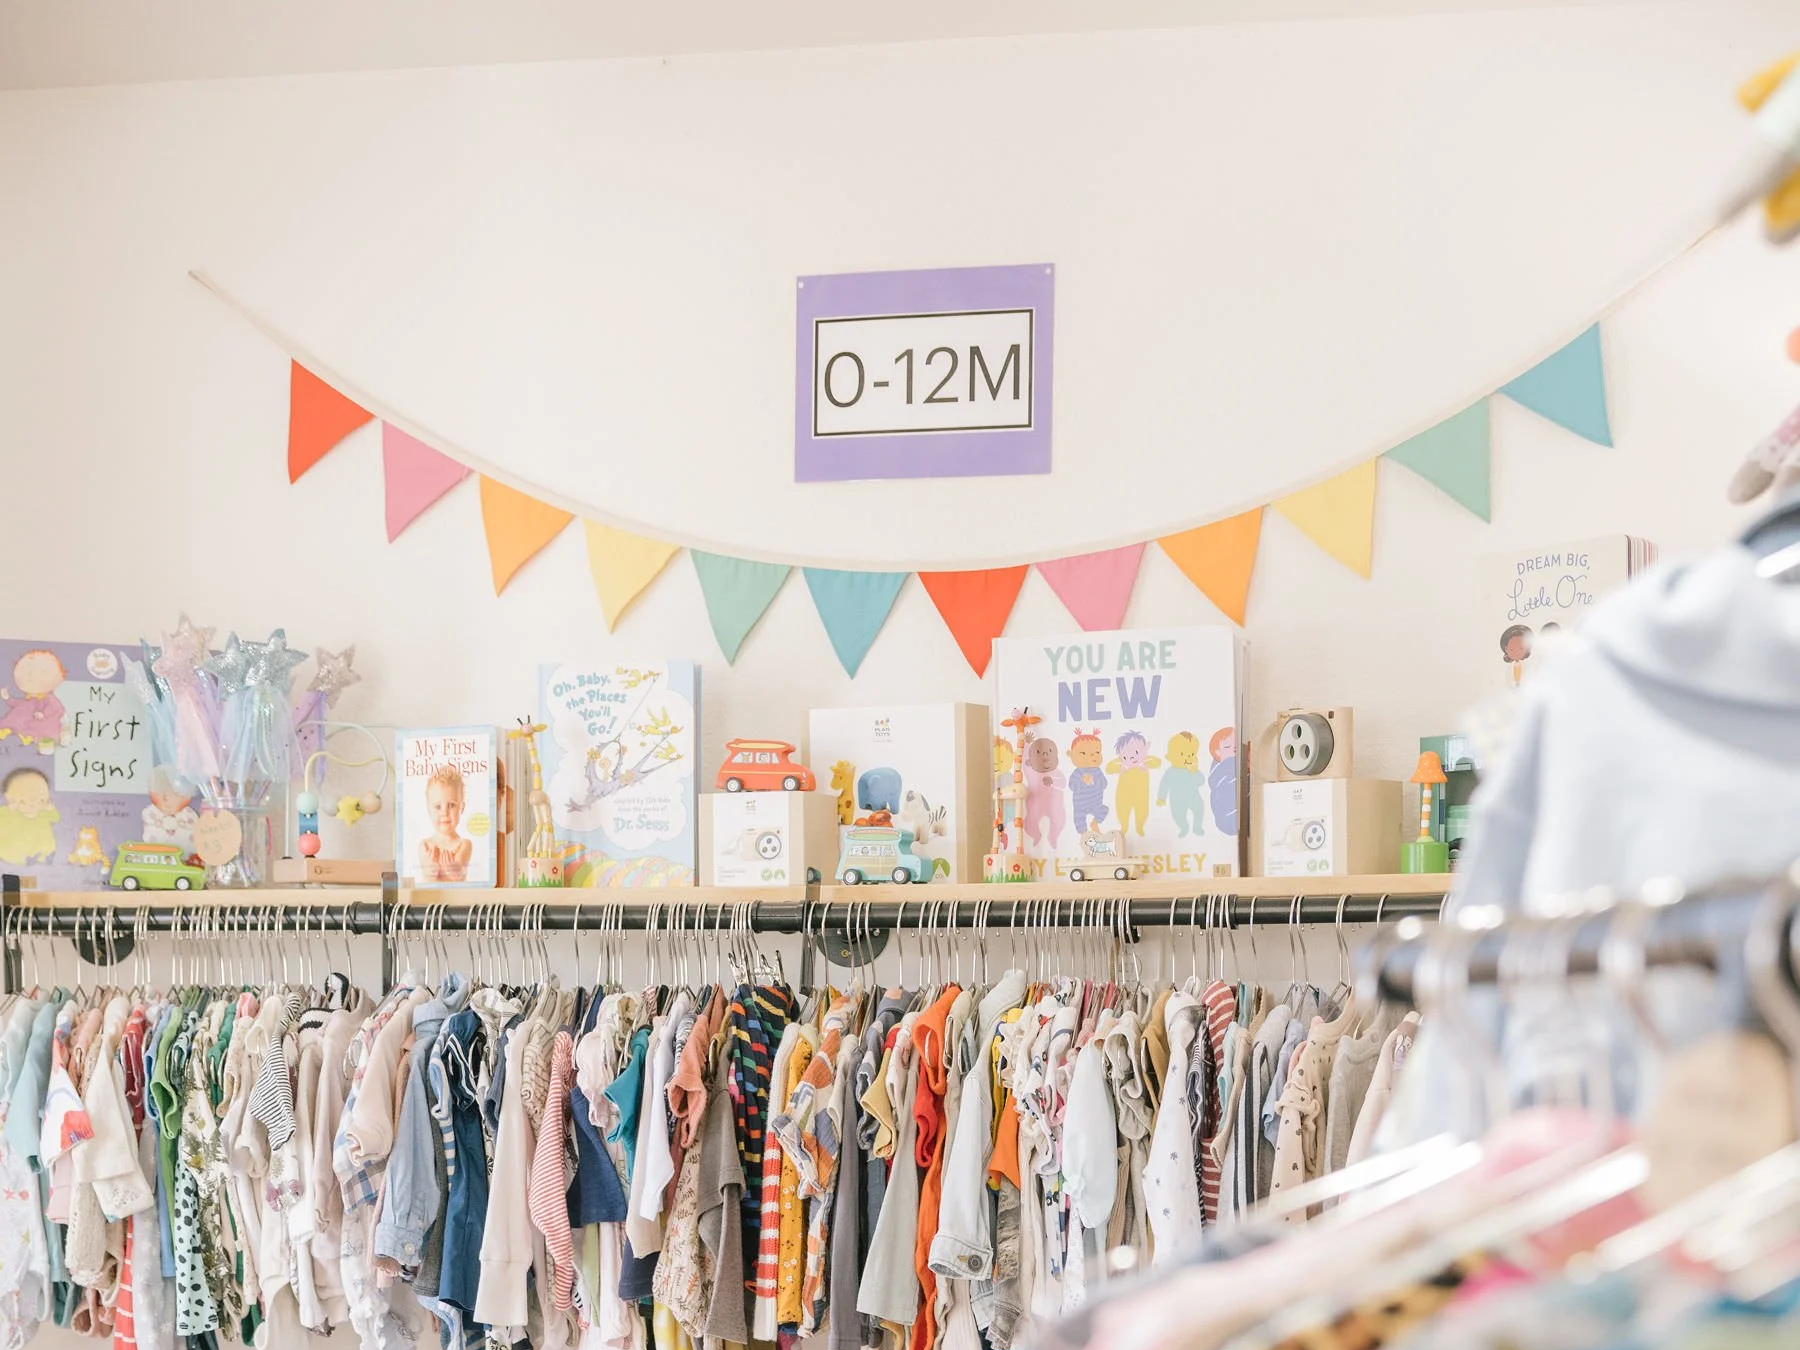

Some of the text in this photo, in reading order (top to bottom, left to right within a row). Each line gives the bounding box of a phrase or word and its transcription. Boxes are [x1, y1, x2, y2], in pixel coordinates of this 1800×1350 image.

[824, 343, 1021, 408] 0-12M
[1517, 552, 1590, 576] DREAM BIG,
[1506, 574, 1593, 621] Little One
[1043, 639, 1177, 677] YOU ARE
[89, 685, 116, 705] My
[565, 688, 627, 711] the Places
[1057, 674, 1163, 723] NEW
[74, 708, 141, 741] First
[578, 705, 611, 721] You'll
[587, 716, 618, 737] Go!
[415, 737, 477, 759] My First
[70, 747, 138, 788] Signs
[405, 757, 488, 779] Baby Signs
[613, 813, 671, 834] Dr. Seuss
